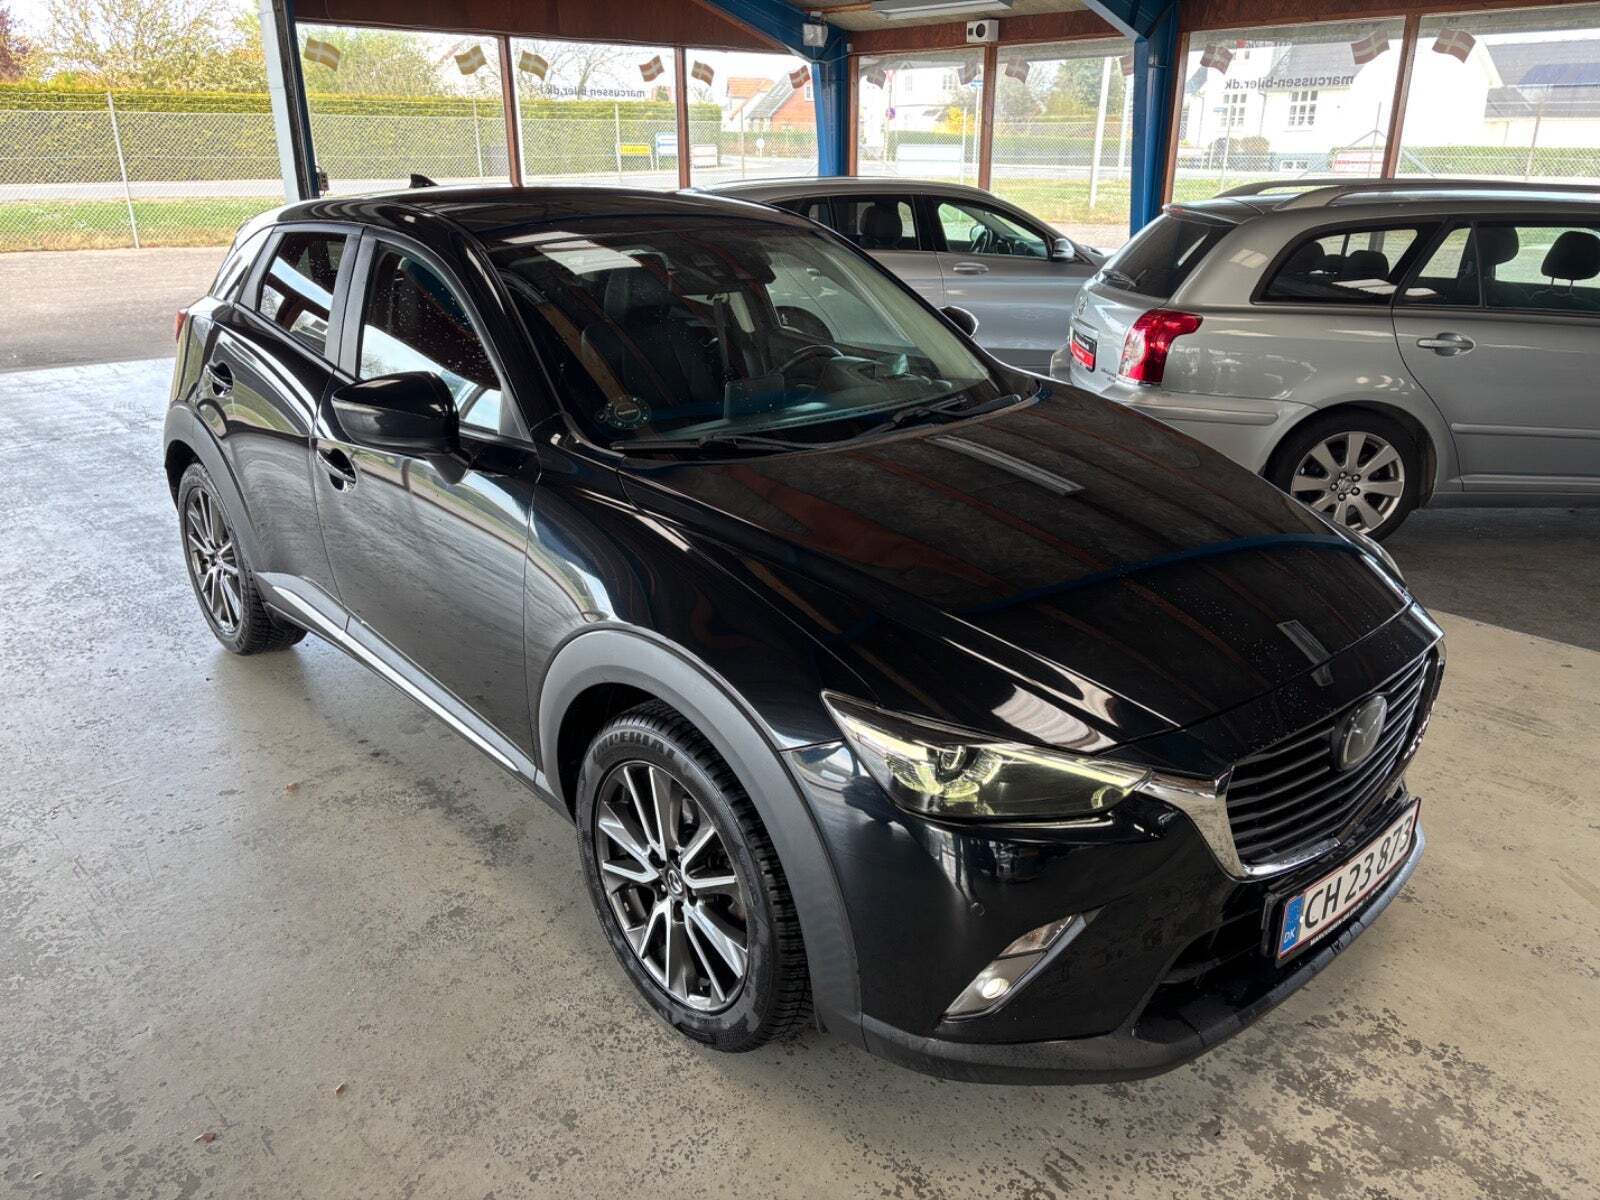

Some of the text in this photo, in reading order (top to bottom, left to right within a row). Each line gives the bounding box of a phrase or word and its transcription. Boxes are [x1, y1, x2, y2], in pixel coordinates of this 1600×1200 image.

[1304, 876, 1343, 929] CH
[1344, 852, 1375, 904] 23
[1376, 815, 1413, 875] 873
[1283, 927, 1296, 943] DK
